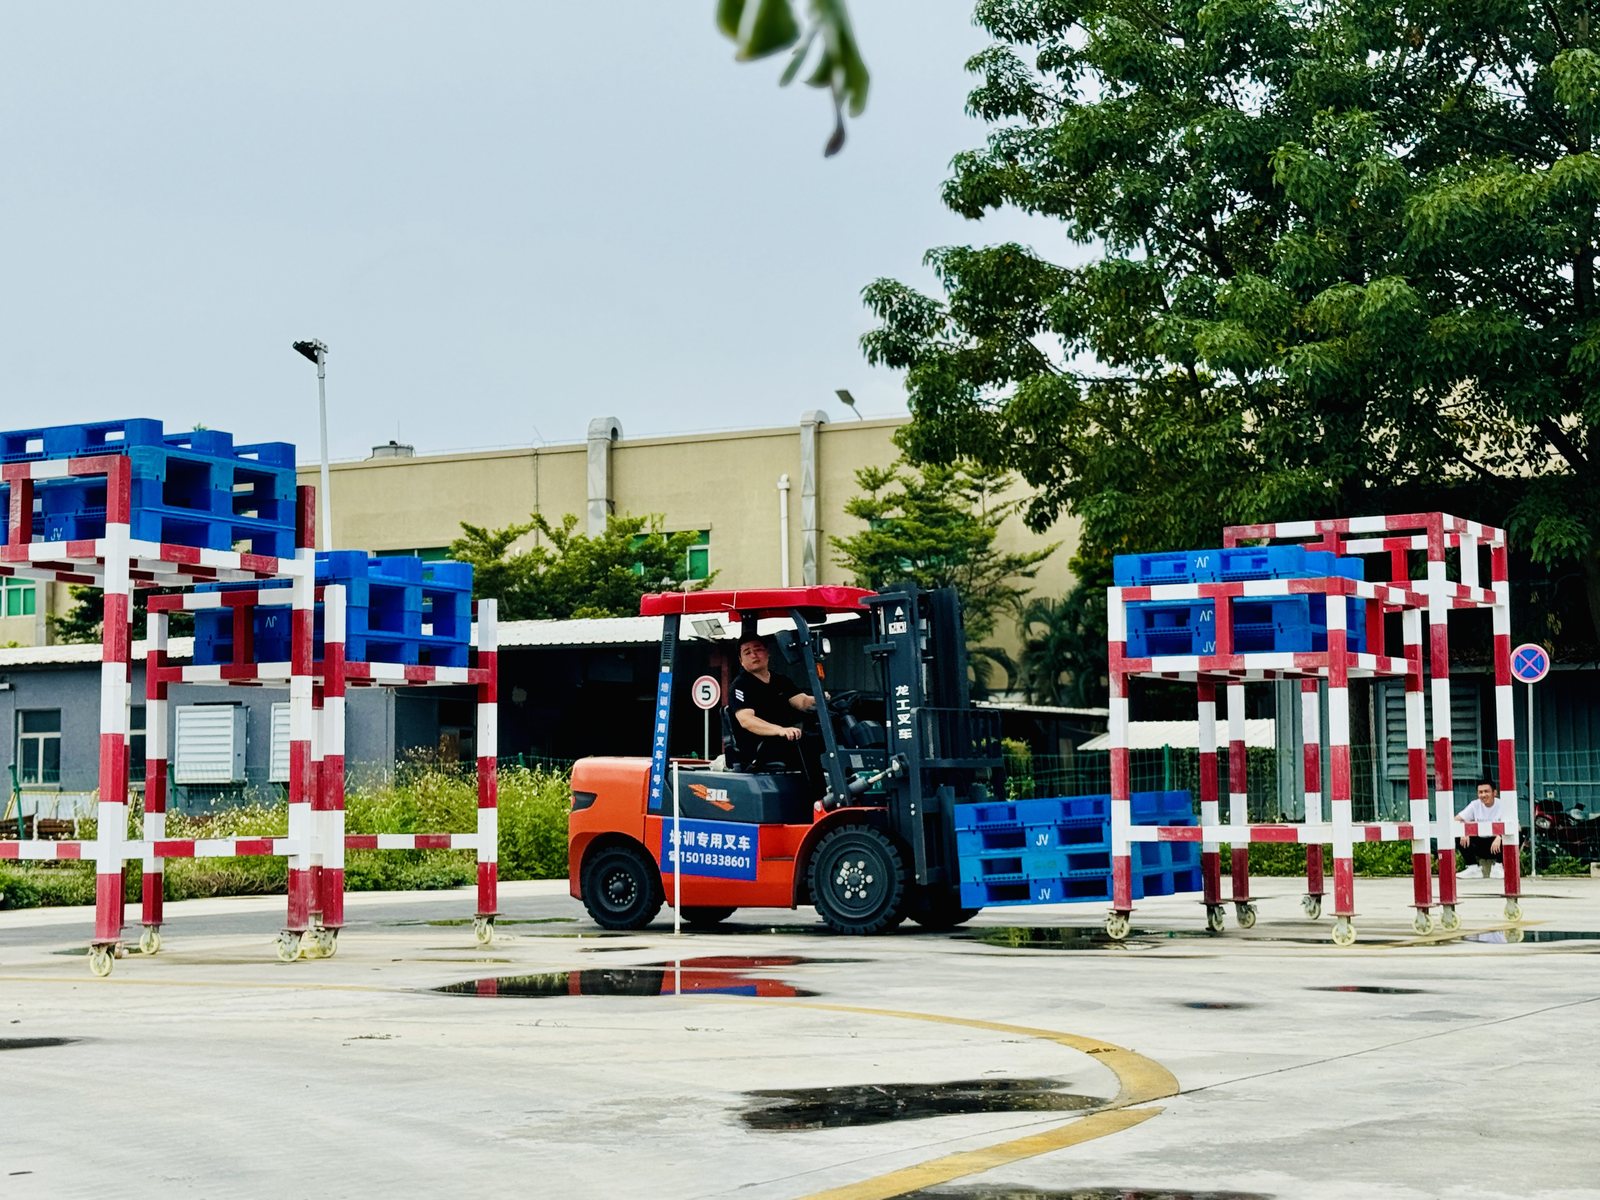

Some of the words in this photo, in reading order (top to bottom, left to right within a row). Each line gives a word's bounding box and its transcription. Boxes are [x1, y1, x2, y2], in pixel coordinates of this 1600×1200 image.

[1202, 641, 1216, 653] JV
[701, 685, 712, 701] 5
[895, 685, 913, 739] 龙工叉车
[1036, 834, 1049, 846] JV
[681, 851, 750, 869] 15018338601
[1038, 888, 1050, 900] JV
